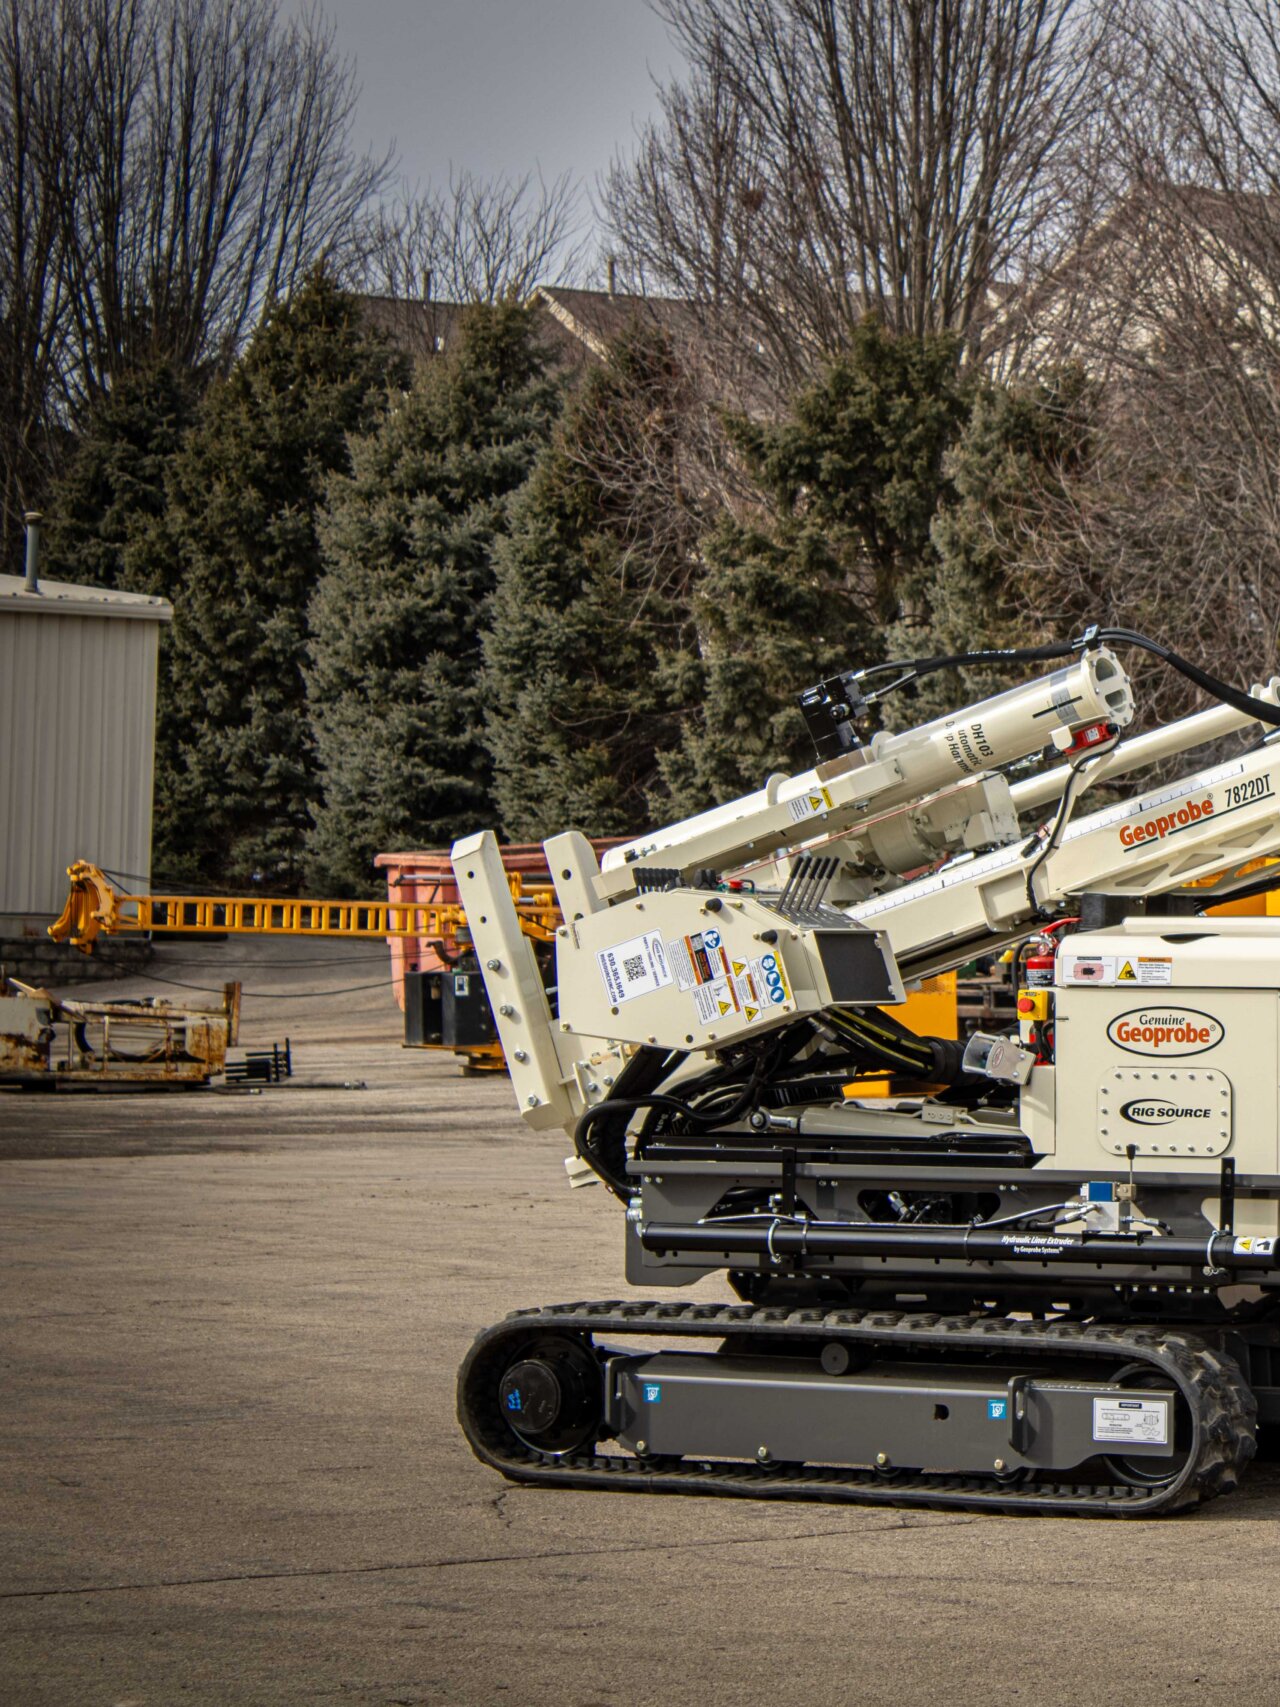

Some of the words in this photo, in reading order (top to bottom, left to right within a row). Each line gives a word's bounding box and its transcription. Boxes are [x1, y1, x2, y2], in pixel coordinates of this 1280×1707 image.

[944, 720, 955, 742] Dp
[971, 723, 994, 757] DH103
[958, 729, 983, 767] utomatic
[1224, 773, 1271, 808] 7822DT
[606, 952, 625, 998] 630.365.1649
[1139, 1014, 1185, 1026] Genuine
[1132, 1107, 1155, 1117] RIG
[1156, 1108, 1211, 1118] SOURCE
[1001, 1235, 1031, 1245] Hydraulic
[1031, 1236, 1046, 1244] Liner
[1046, 1237, 1074, 1245] Extruder
[1013, 1246, 1020, 1254] by
